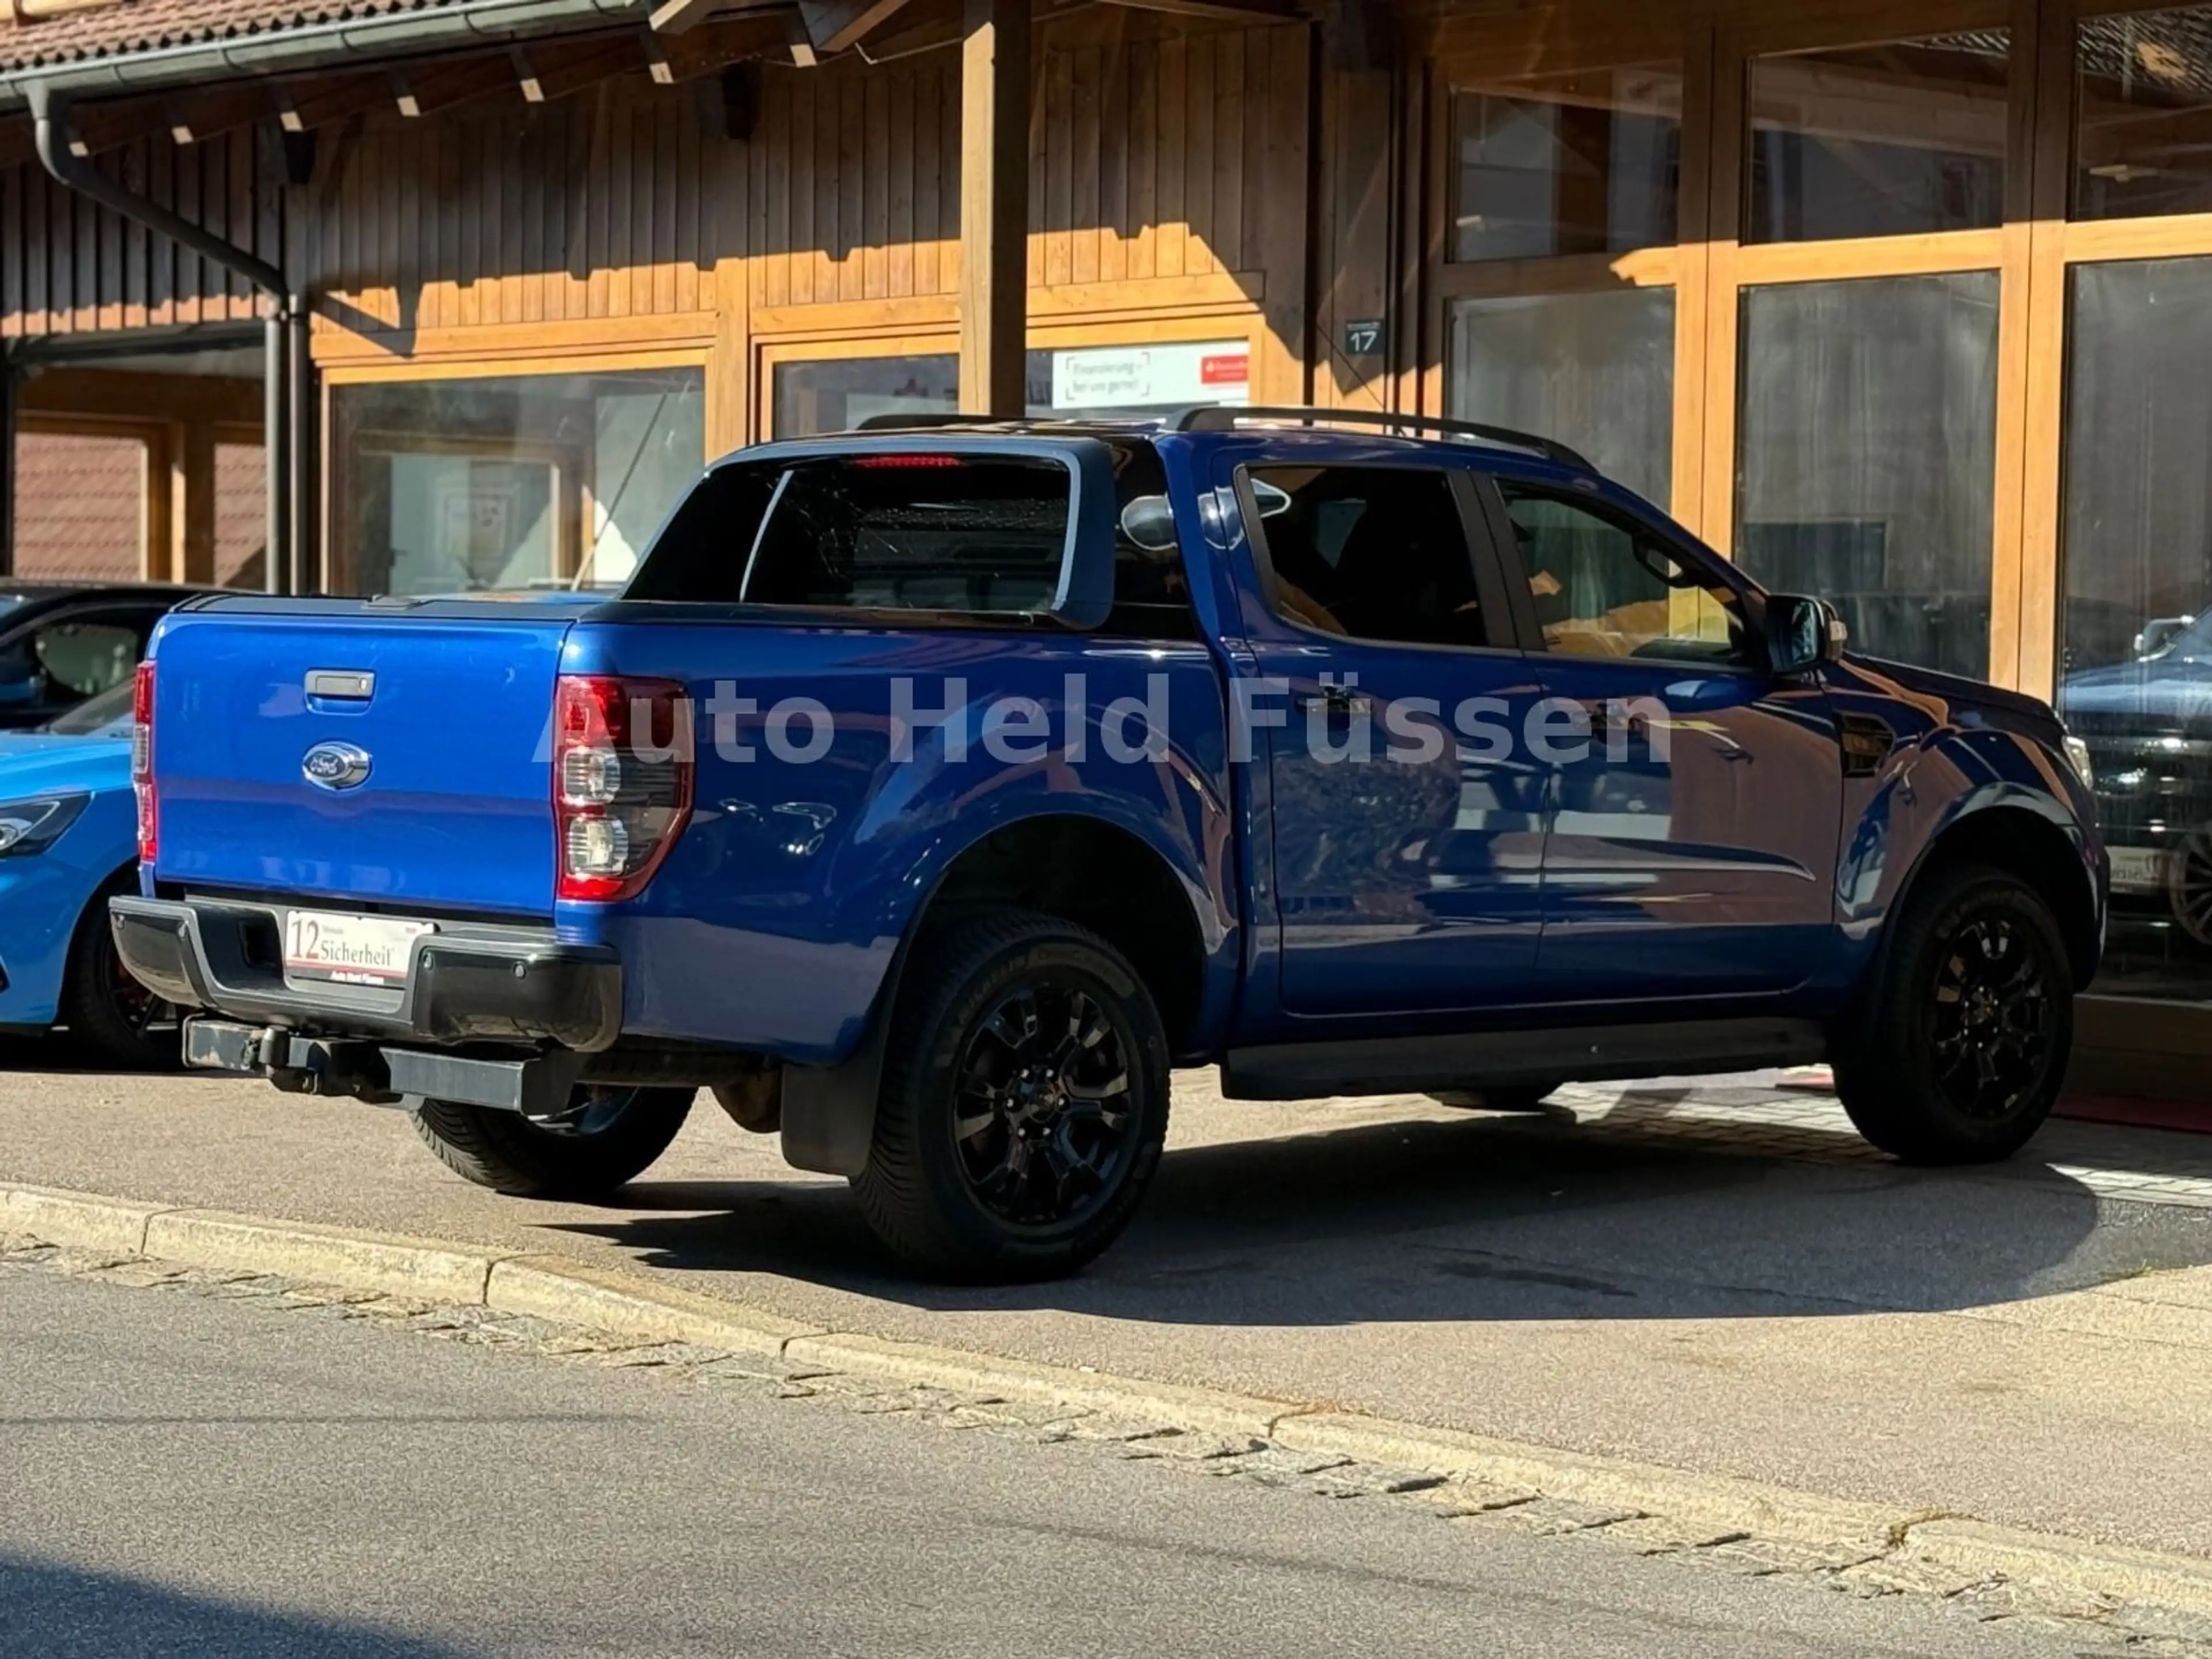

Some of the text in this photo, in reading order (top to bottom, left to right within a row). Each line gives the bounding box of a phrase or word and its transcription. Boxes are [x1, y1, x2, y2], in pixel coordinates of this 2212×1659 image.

[1350, 331, 1377, 352] 17
[290, 918, 392, 967] 12 Sicherheit
